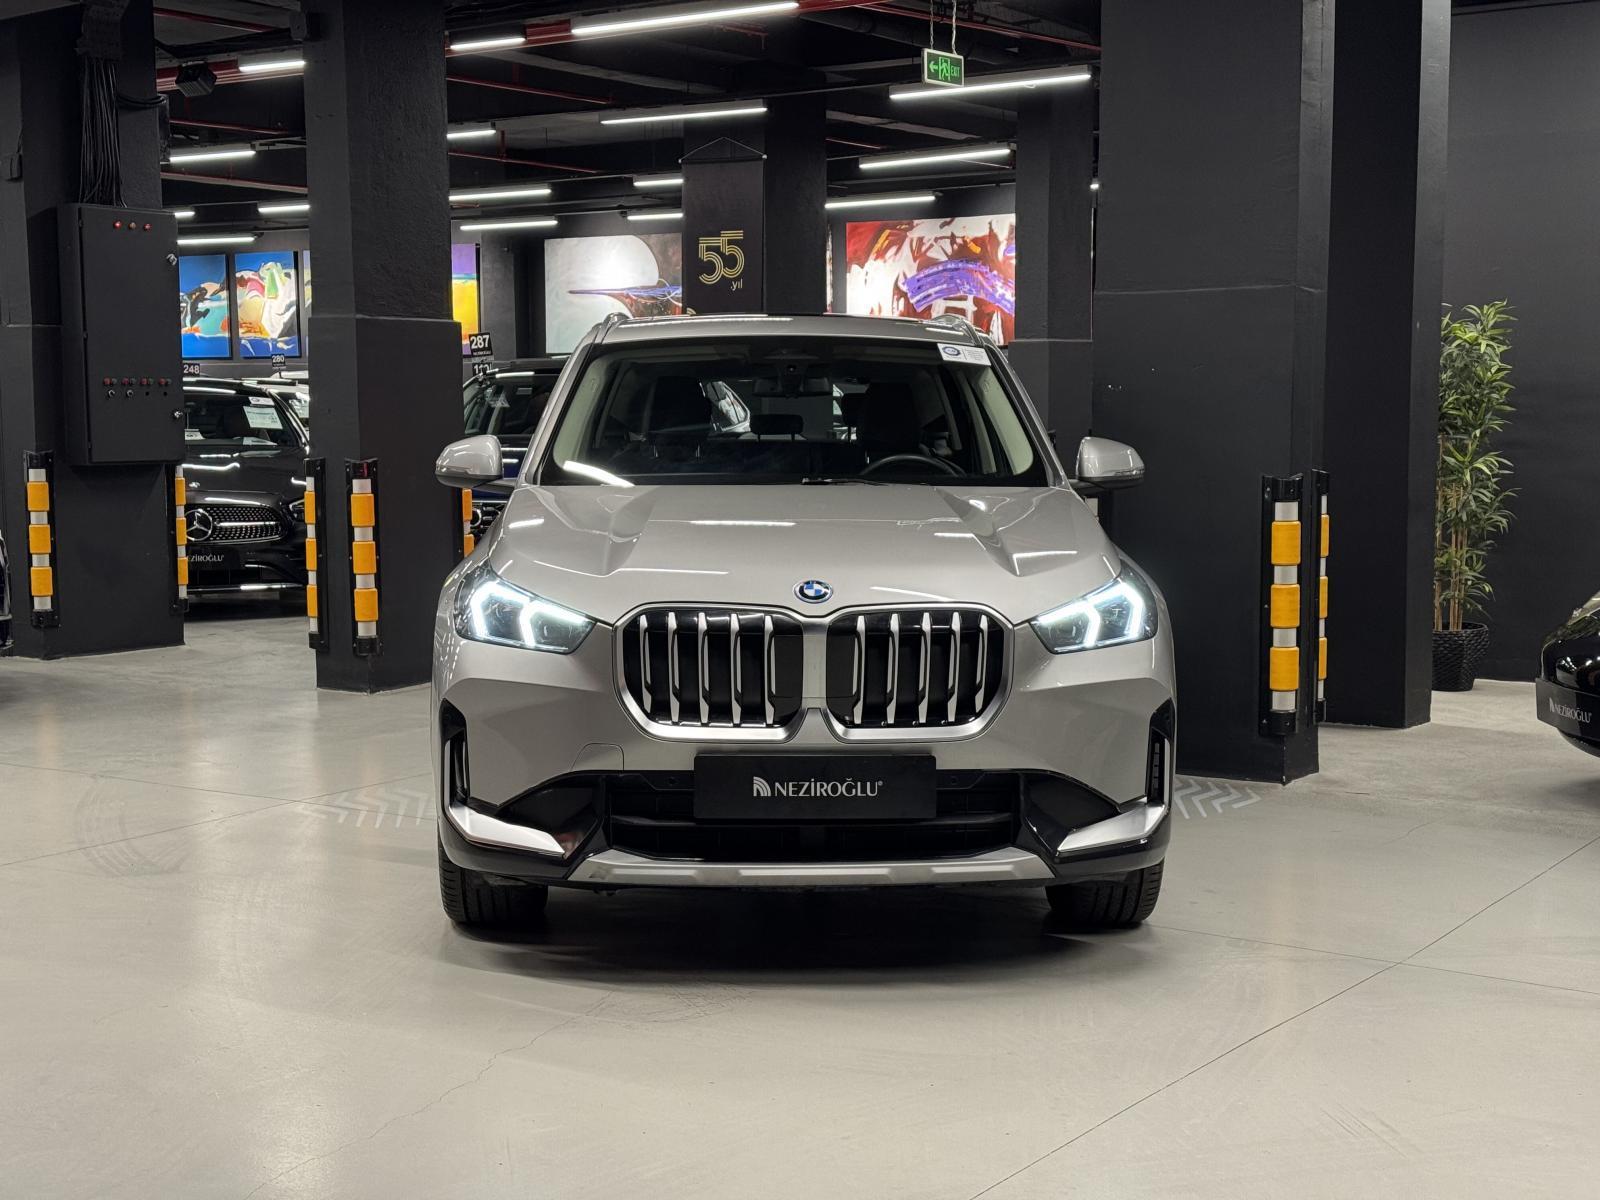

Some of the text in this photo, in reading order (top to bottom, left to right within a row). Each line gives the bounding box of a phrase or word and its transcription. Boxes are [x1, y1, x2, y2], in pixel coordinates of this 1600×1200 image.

[699, 230, 745, 285] 55
[470, 334, 490, 349] 287
[183, 364, 200, 375] 248
[187, 553, 223, 562] ZİROĞLU
[774, 777, 879, 797] NEZİROĞLU
